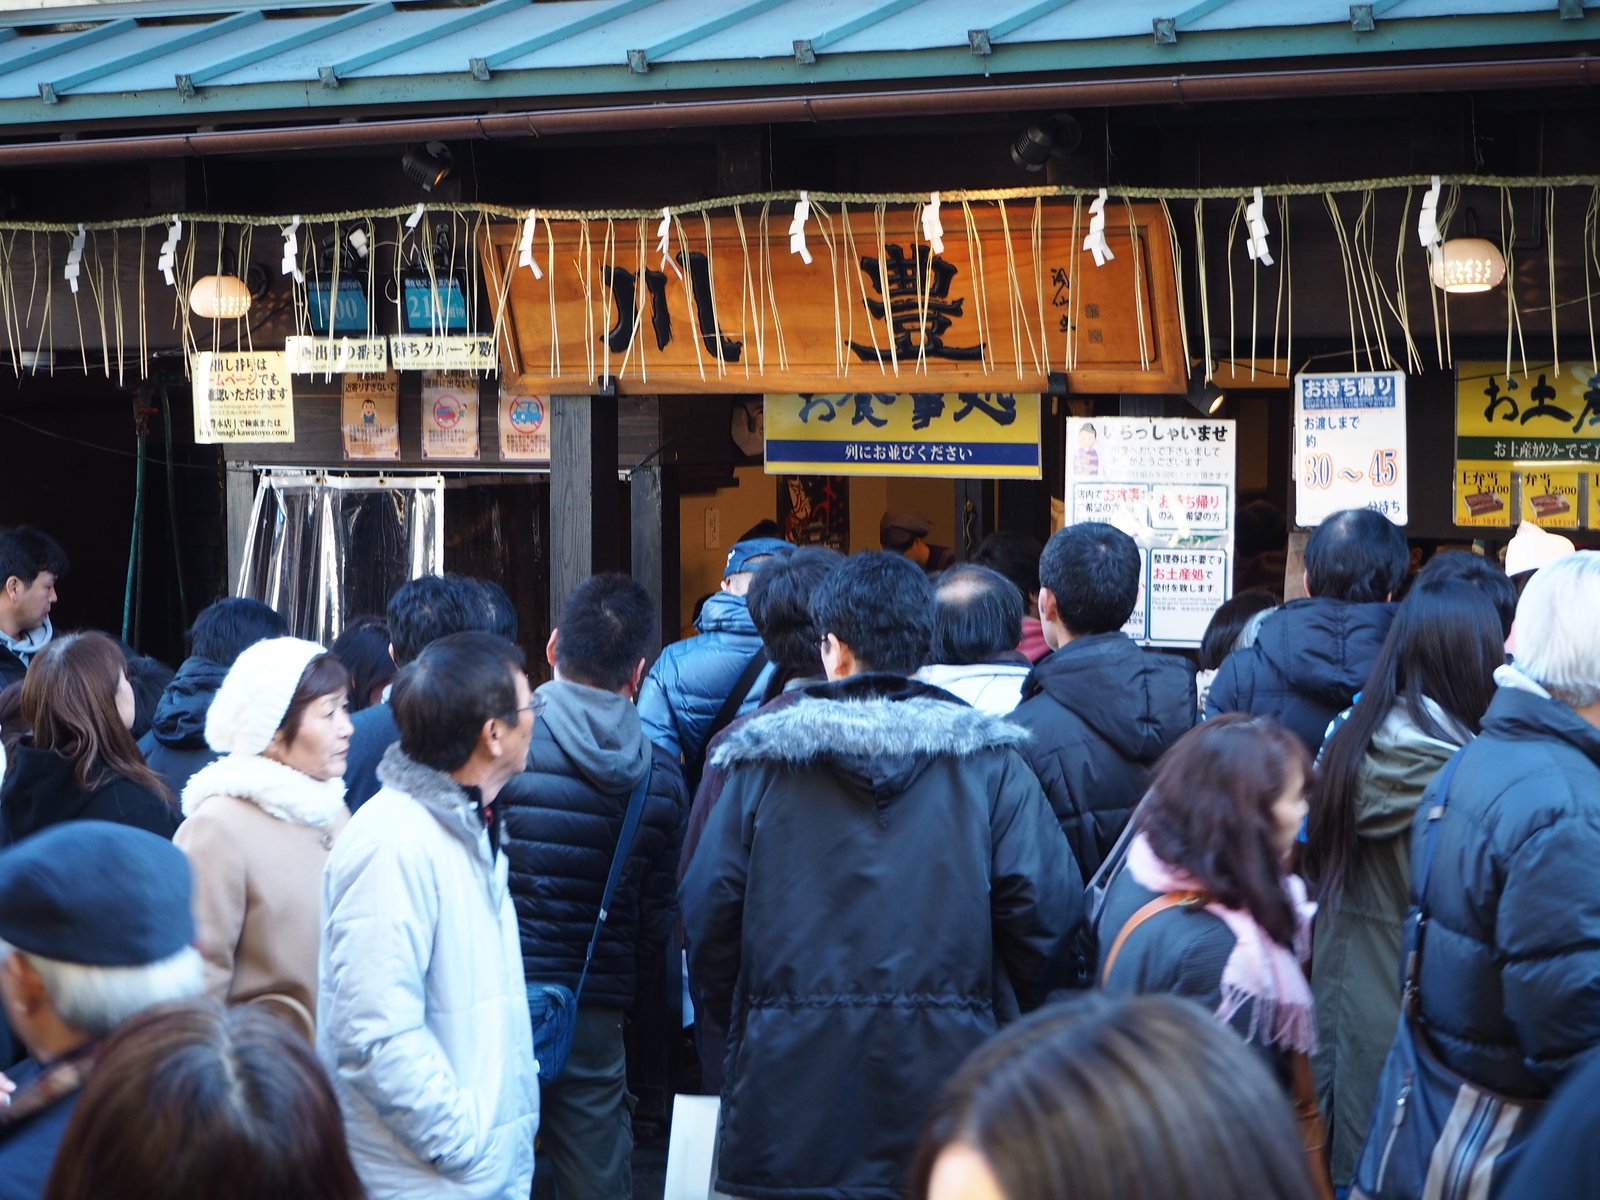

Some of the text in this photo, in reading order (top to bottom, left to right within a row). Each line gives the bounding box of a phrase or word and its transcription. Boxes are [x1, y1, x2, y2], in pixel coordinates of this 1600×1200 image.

[1304, 377, 1392, 398] お持ち帰り
[1304, 416, 1360, 430] お渡しまで
[1305, 434, 1317, 448] 約
[845, 443, 973, 462] 列にお並びください
[1159, 494, 1220, 510] おち帰り
[1154, 554, 1222, 565] 整理券は不要です
[1153, 568, 1213, 582] お土産処で
